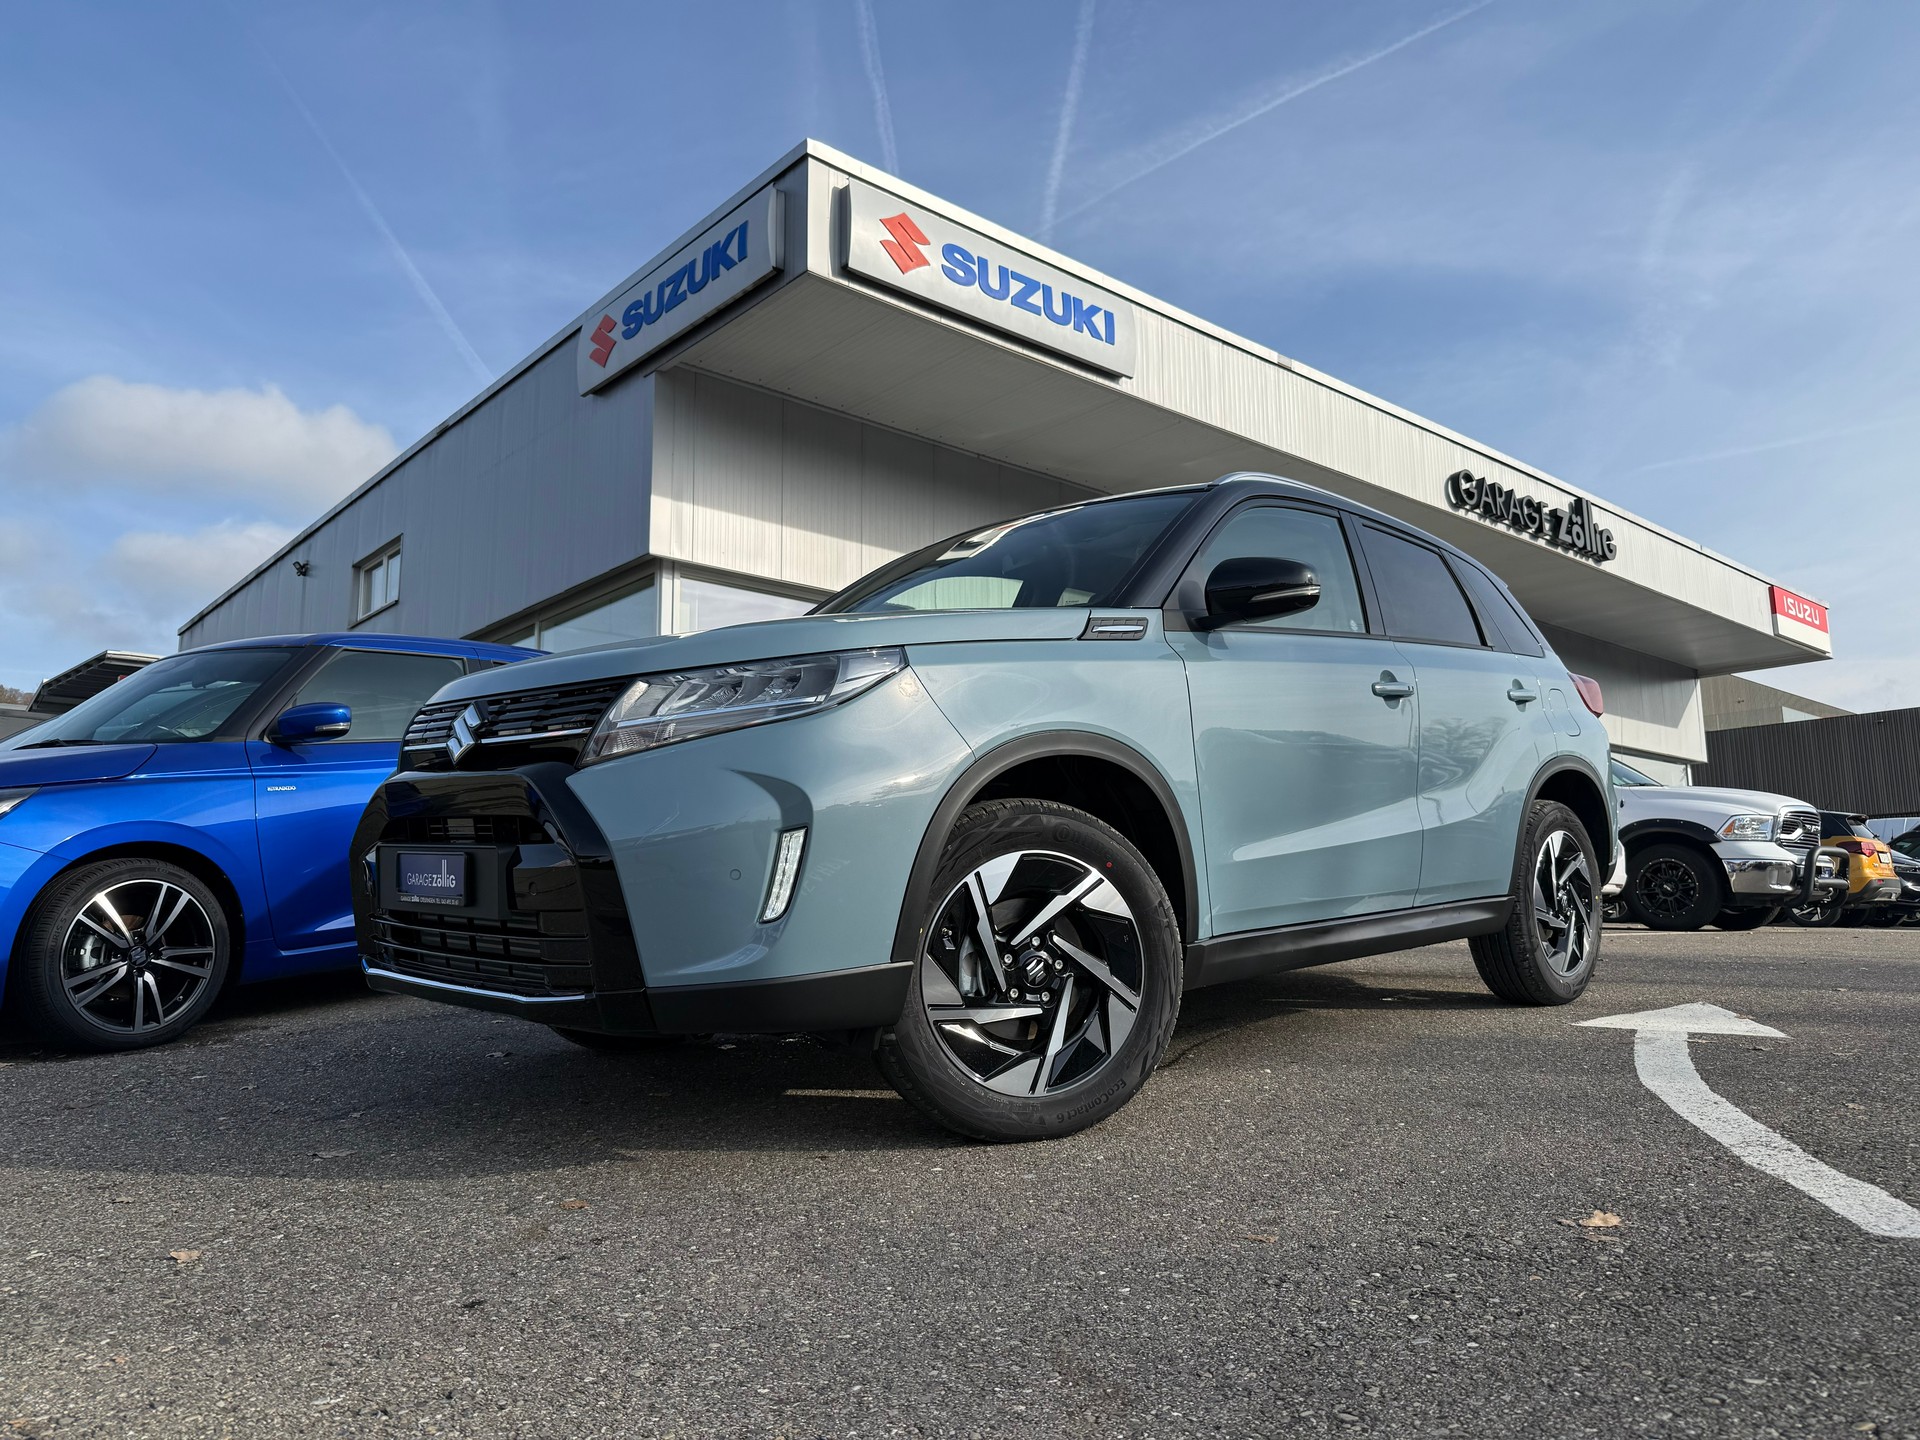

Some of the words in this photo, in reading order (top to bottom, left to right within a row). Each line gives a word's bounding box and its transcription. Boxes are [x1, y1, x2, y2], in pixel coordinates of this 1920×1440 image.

[621, 220, 749, 340] SUZUKI
[941, 243, 1116, 346] SUZUKI
[1452, 469, 1553, 535] GARAGE
[1783, 596, 1819, 625] ISUZU
[1056, 1112, 1065, 1124] 6
[1066, 1078, 1127, 1121] EcoContact
